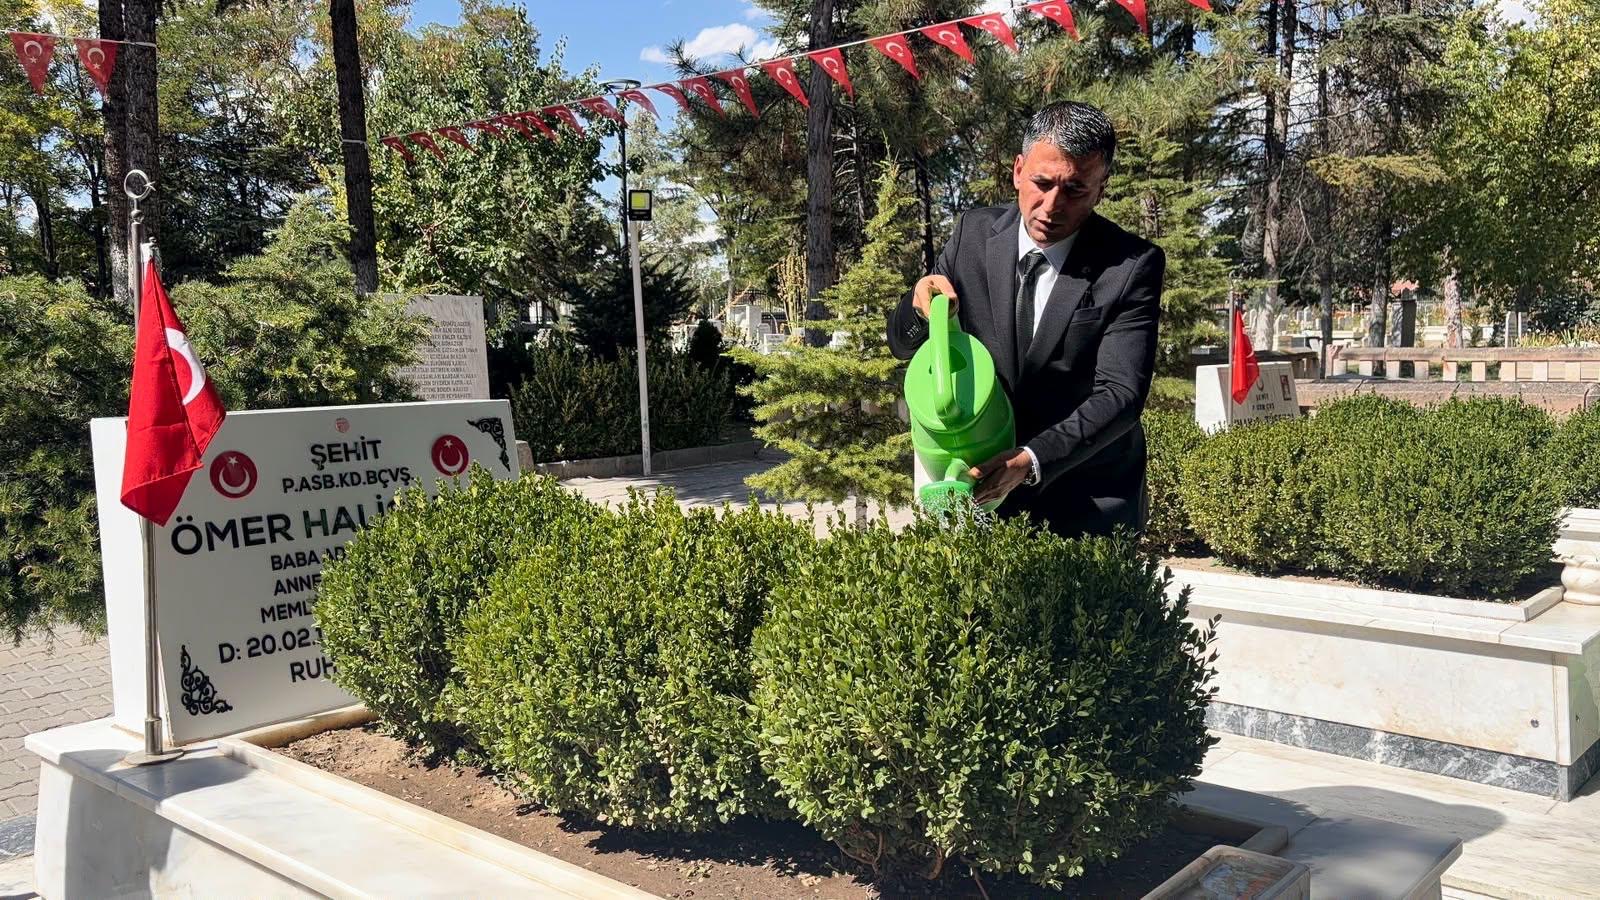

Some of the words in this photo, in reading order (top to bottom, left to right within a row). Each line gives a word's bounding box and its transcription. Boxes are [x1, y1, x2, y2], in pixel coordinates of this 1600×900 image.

[310, 435, 382, 471] ŞEHİT
[282, 467, 415, 494] P.ASB.KD.BÇVŞ.
[171, 514, 295, 556] ÖMER
[270, 550, 321, 571] BABA
[218, 642, 242, 664] D:
